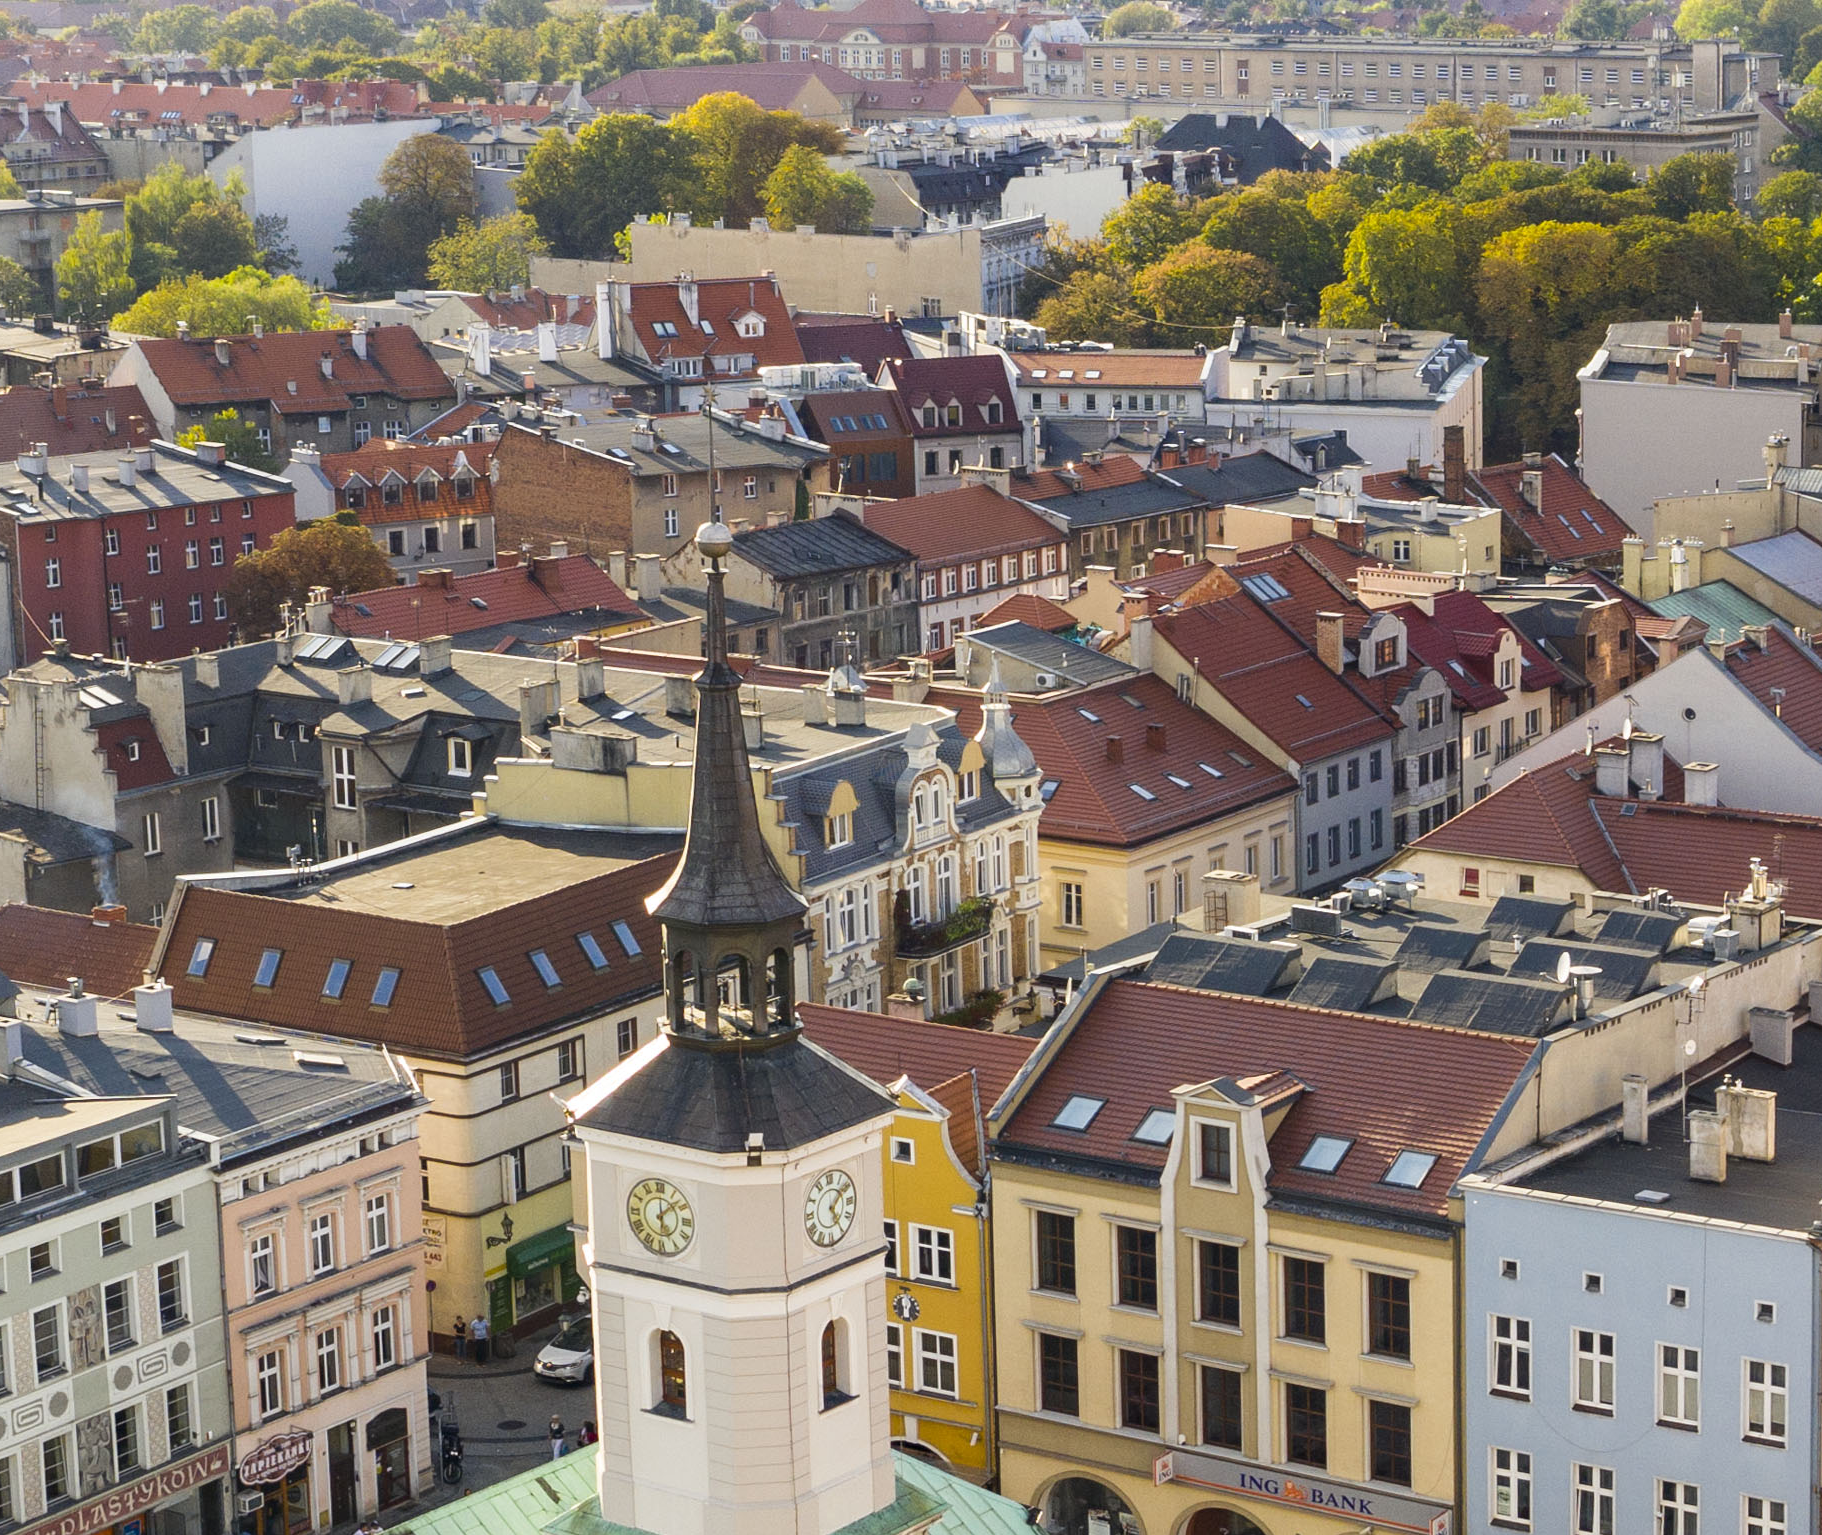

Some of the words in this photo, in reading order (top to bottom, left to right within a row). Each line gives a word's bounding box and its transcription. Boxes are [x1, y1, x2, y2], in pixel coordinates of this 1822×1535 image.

[1159, 1468, 1171, 1482] ING
[1240, 1473, 1279, 1495] ING
[1311, 1489, 1373, 1515] BANK
